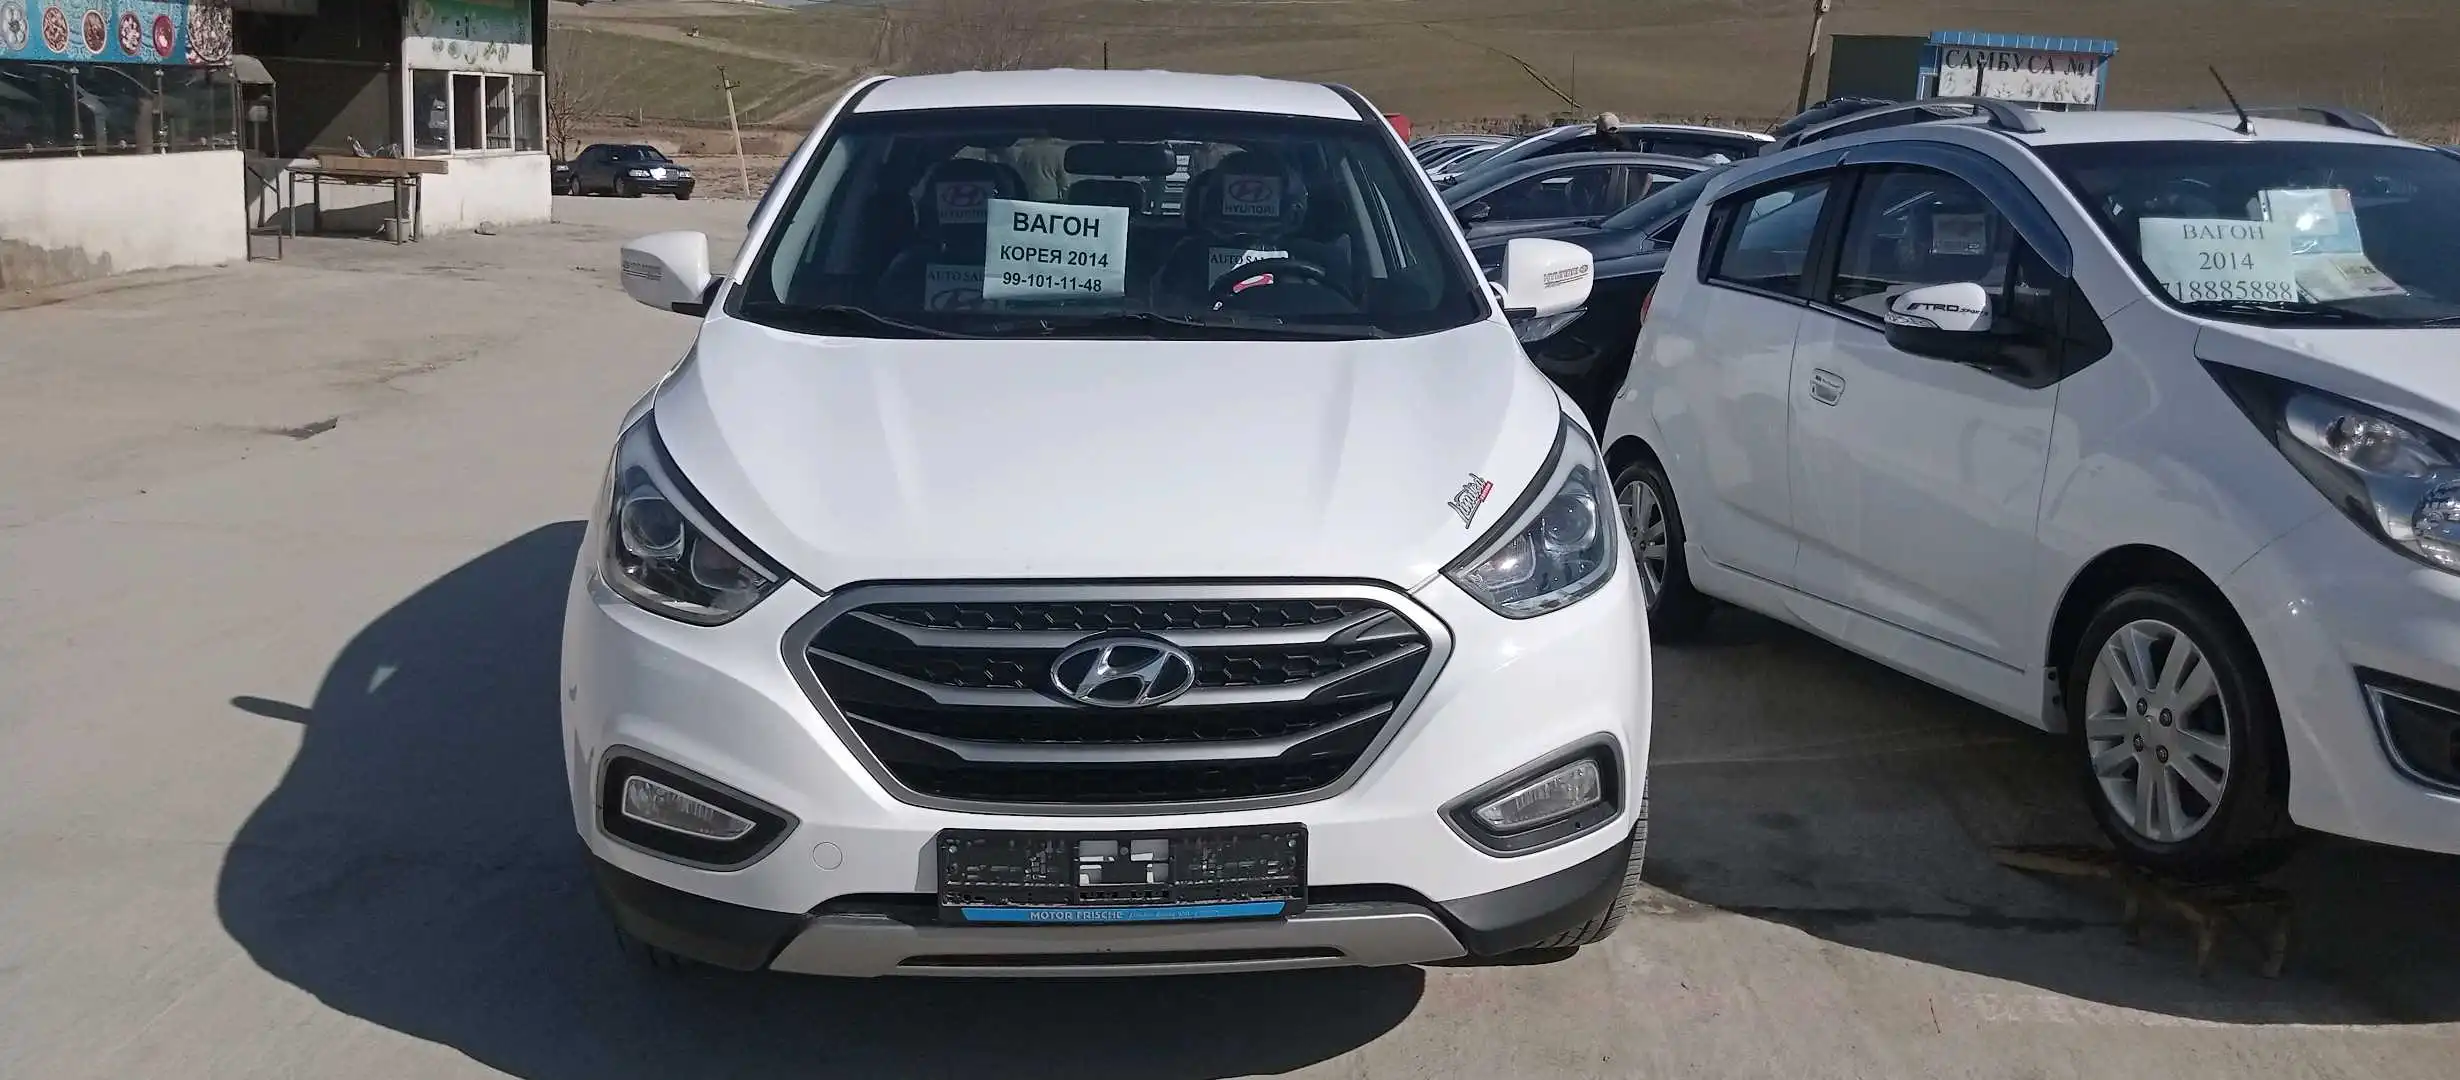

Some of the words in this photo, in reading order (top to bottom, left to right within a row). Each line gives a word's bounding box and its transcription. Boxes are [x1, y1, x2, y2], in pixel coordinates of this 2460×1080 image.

[1945, 50, 2055, 75] САМБУСА
[1013, 211, 1100, 238] ВАГОН
[2182, 224, 2264, 240] ВАГОН
[1000, 245, 1061, 264] КОРЕЯ
[1068, 250, 1108, 268] 2014
[2198, 251, 2255, 270] 2014
[1002, 271, 1102, 292] 99-101-11-48
[1030, 911, 1073, 920] MOTOR
